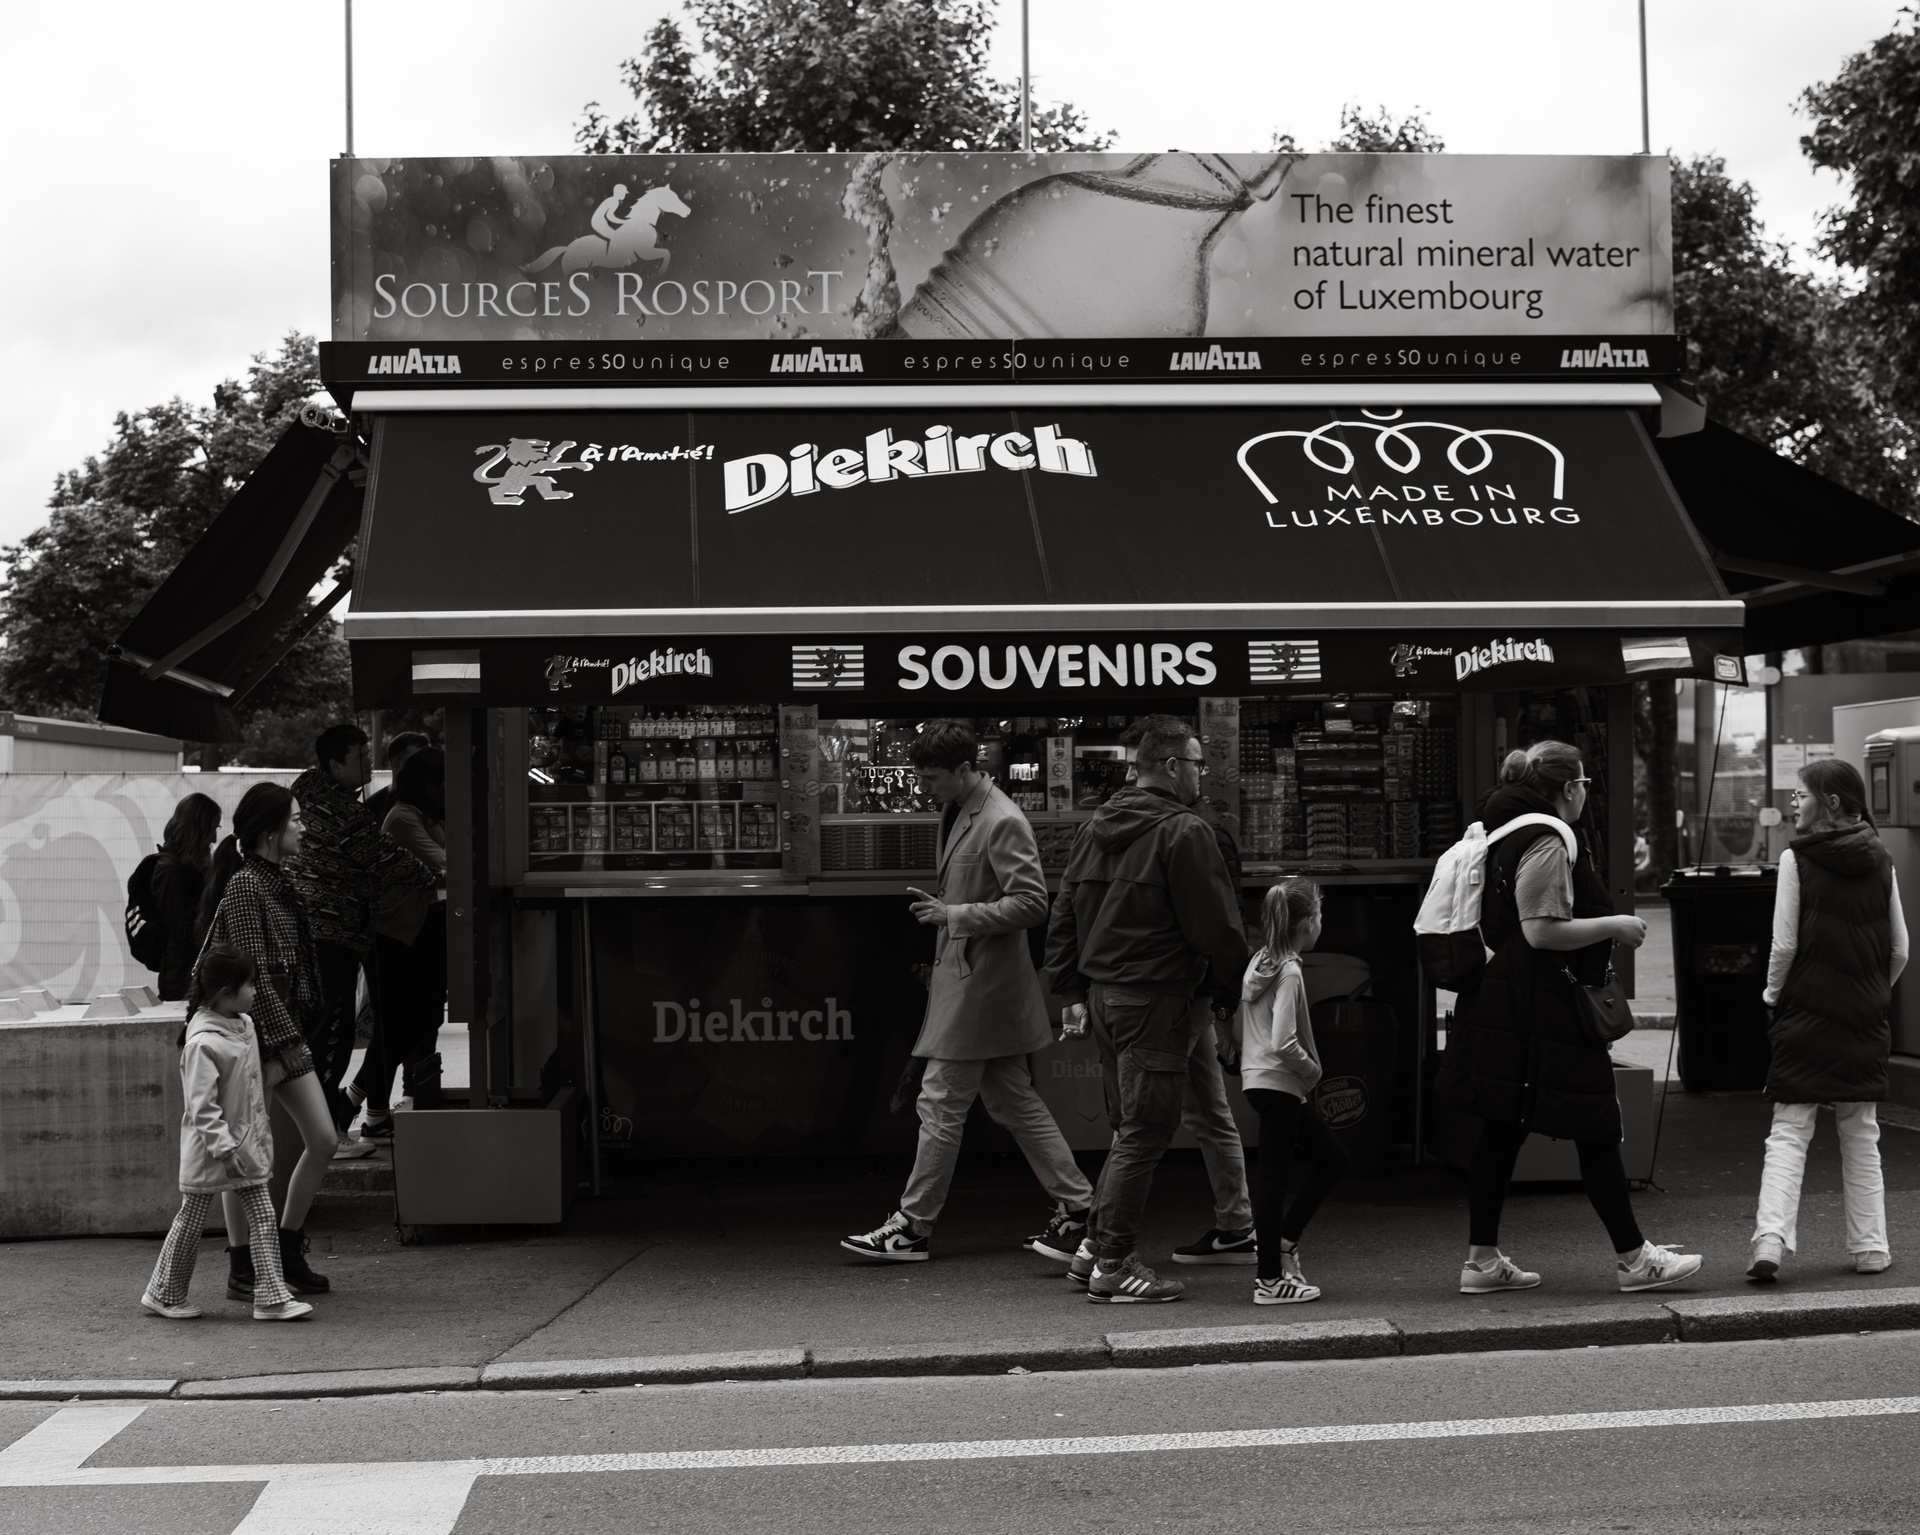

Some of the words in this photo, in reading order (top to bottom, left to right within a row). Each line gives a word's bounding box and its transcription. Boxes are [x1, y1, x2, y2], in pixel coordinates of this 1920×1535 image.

[1290, 194, 1353, 223] The
[1366, 194, 1453, 223] finest
[1294, 237, 1402, 266] natural
[1418, 238, 1533, 267] mineral
[1546, 243, 1640, 267] water
[1294, 280, 1327, 309] of
[1340, 280, 1543, 319] Luxembourg
[367, 347, 462, 374] LAVAZZA
[769, 346, 864, 373] LAVAZZA
[1169, 344, 1262, 371] LAVAZZA
[1560, 342, 1650, 368] LAVAZZA
[724, 424, 1097, 514] Diekirch
[1328, 484, 1454, 501] MADE
[1470, 485, 1515, 501] IN
[1266, 507, 1580, 527] LUXEMBOURG
[611, 647, 713, 695] Diekirch
[898, 642, 1217, 690] SOUVENIRS
[1455, 637, 1554, 681] Diekirch
[653, 997, 855, 1043] Diekirch
[1320, 1093, 1363, 1122] Schöller
